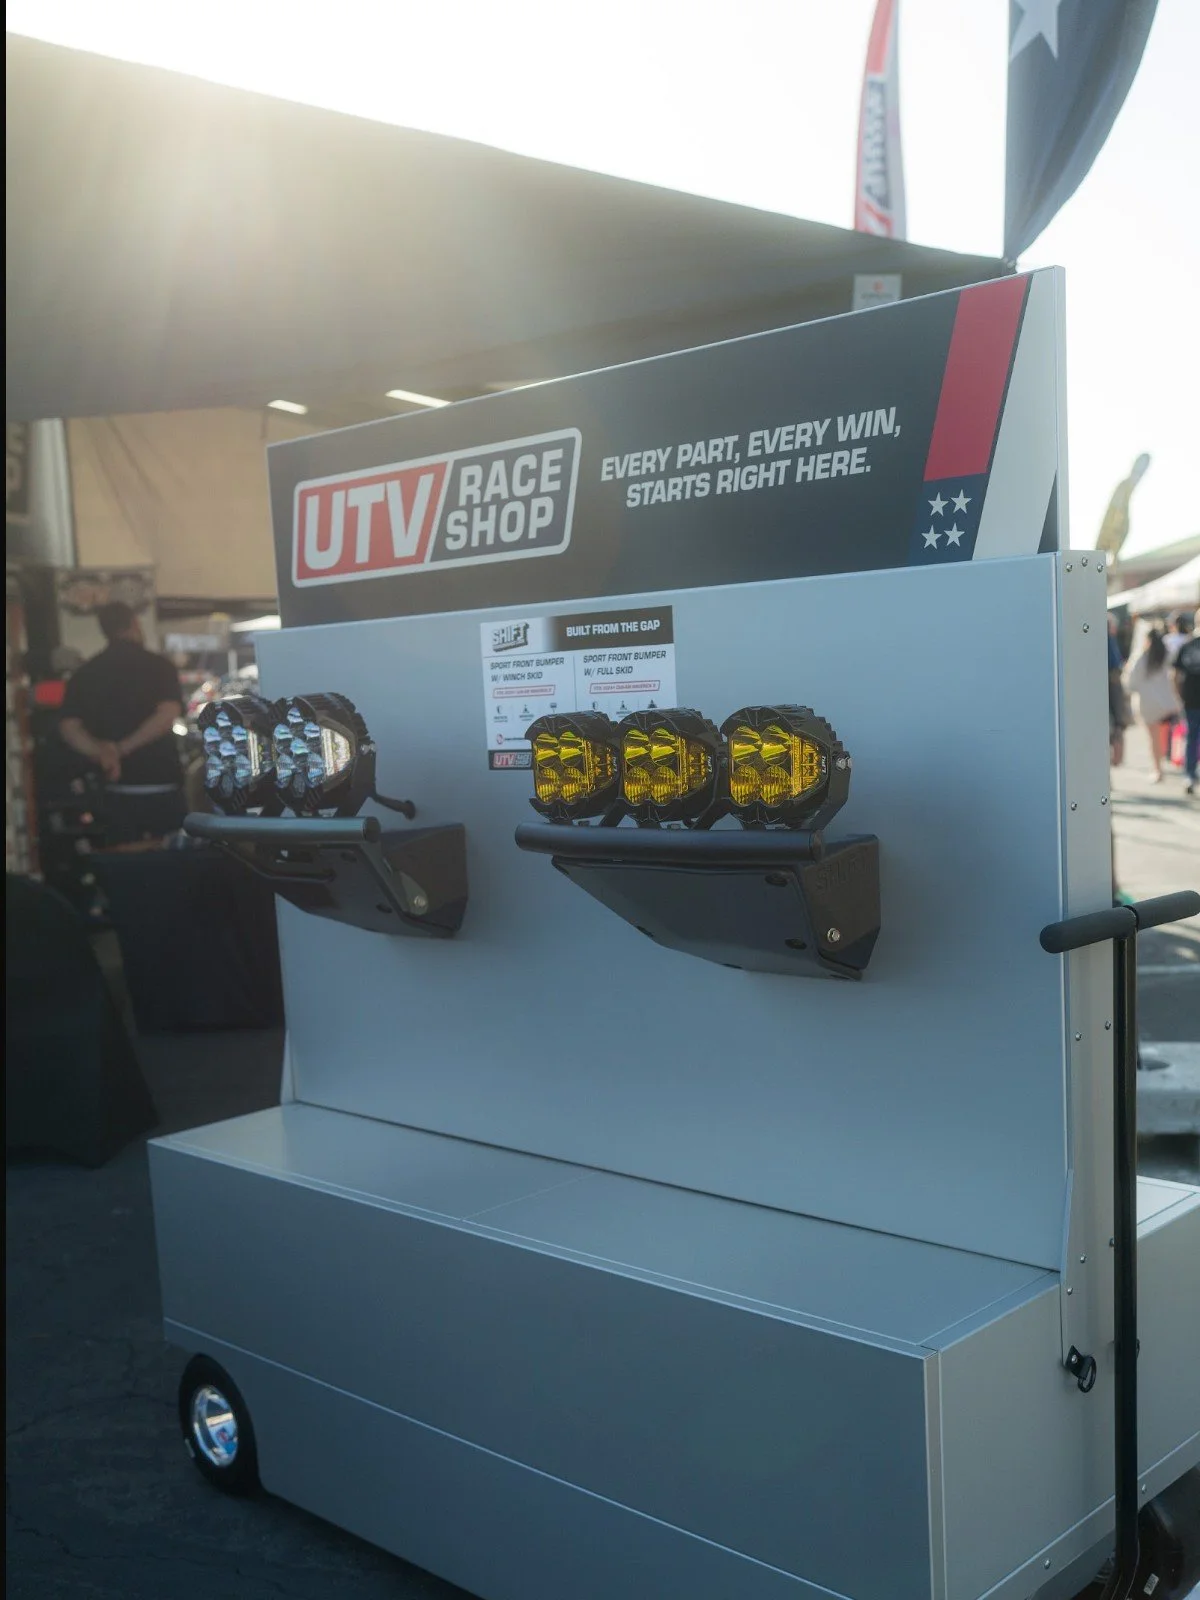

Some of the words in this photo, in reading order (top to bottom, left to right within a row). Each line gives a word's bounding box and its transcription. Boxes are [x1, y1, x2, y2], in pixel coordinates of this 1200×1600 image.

[601, 446, 672, 481] EVERY
[676, 435, 740, 469] PART,
[747, 418, 831, 457] EVERY
[837, 406, 900, 442] WIN,
[458, 448, 564, 507] RACE
[626, 472, 710, 508] STARTS
[716, 458, 792, 495] RIGHT
[795, 447, 871, 483] HERE.
[304, 473, 434, 570] UTV
[445, 496, 554, 550] SHOP
[492, 621, 529, 647] SHIFT
[566, 625, 591, 637] BUILT
[592, 623, 619, 635] FROM
[620, 621, 640, 633] THE
[640, 619, 660, 631] GAP
[490, 661, 511, 670] SPORT
[512, 659, 535, 668] FRONT
[535, 657, 564, 667] BUMPER
[583, 654, 606, 664] SPORT
[608, 652, 632, 662] FRONT
[634, 650, 667, 660] BUMPER
[502, 673, 526, 682] WINCH
[526, 671, 543, 680] SKID
[584, 667, 595, 677] W/
[597, 666, 614, 676] FULL
[616, 665, 633, 674] SKID
